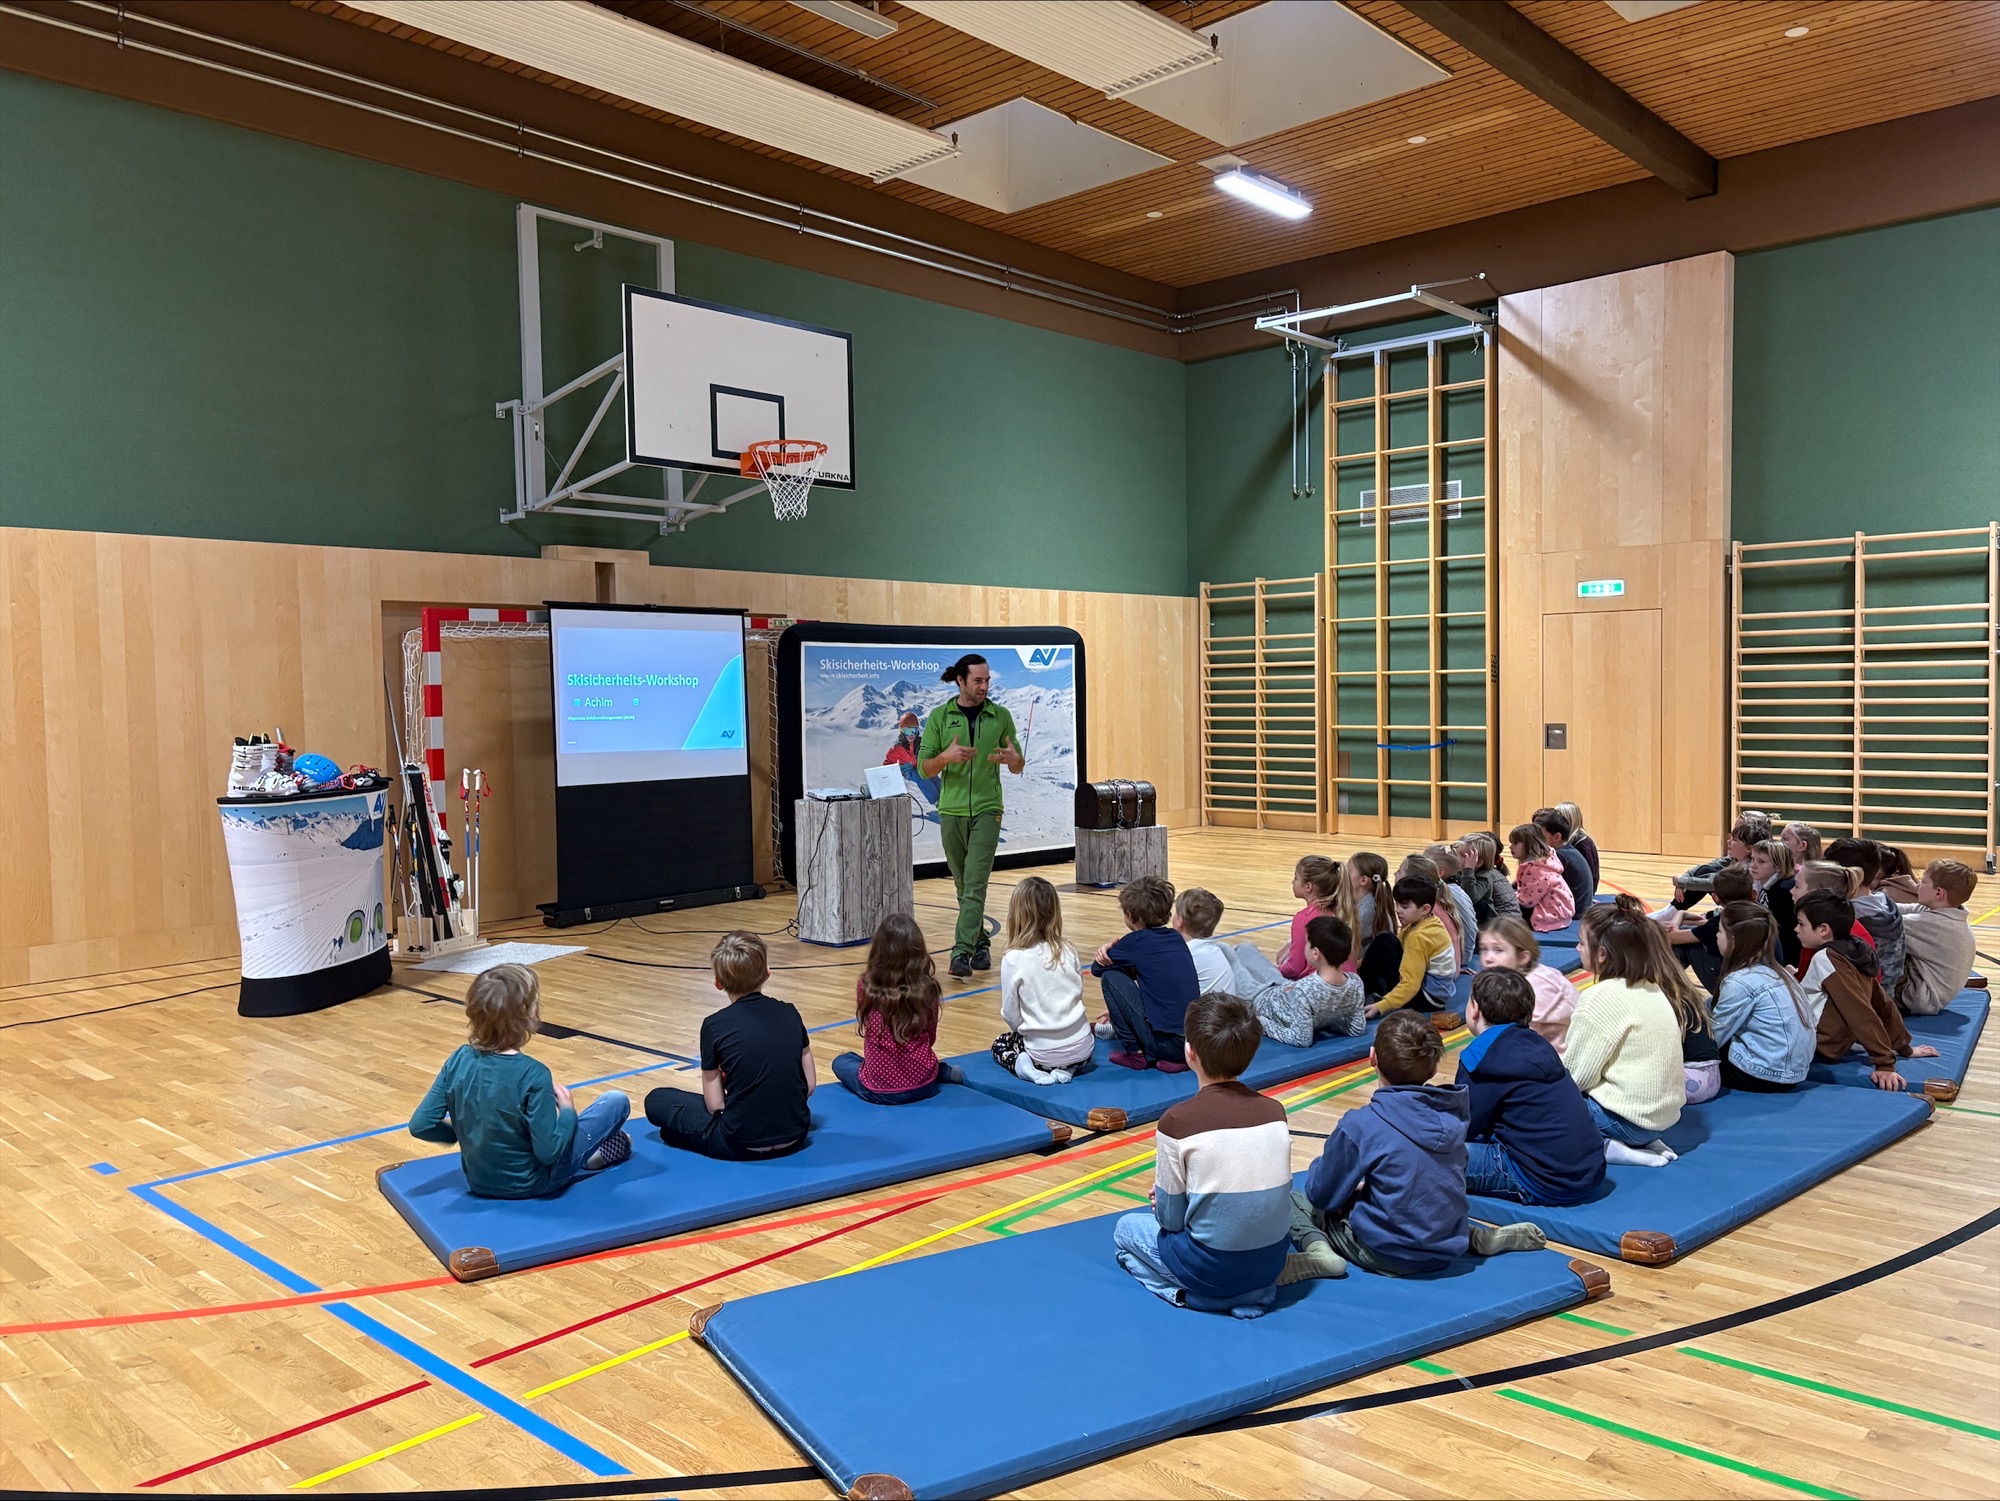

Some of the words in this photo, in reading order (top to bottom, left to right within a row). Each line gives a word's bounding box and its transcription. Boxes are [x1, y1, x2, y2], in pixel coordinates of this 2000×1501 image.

[814, 471, 850, 481] URKNA
[820, 659, 940, 672] Skisicherheits-Workshop
[567, 674, 699, 688] Skisicherheits-Workshop
[585, 697, 613, 707] Achim
